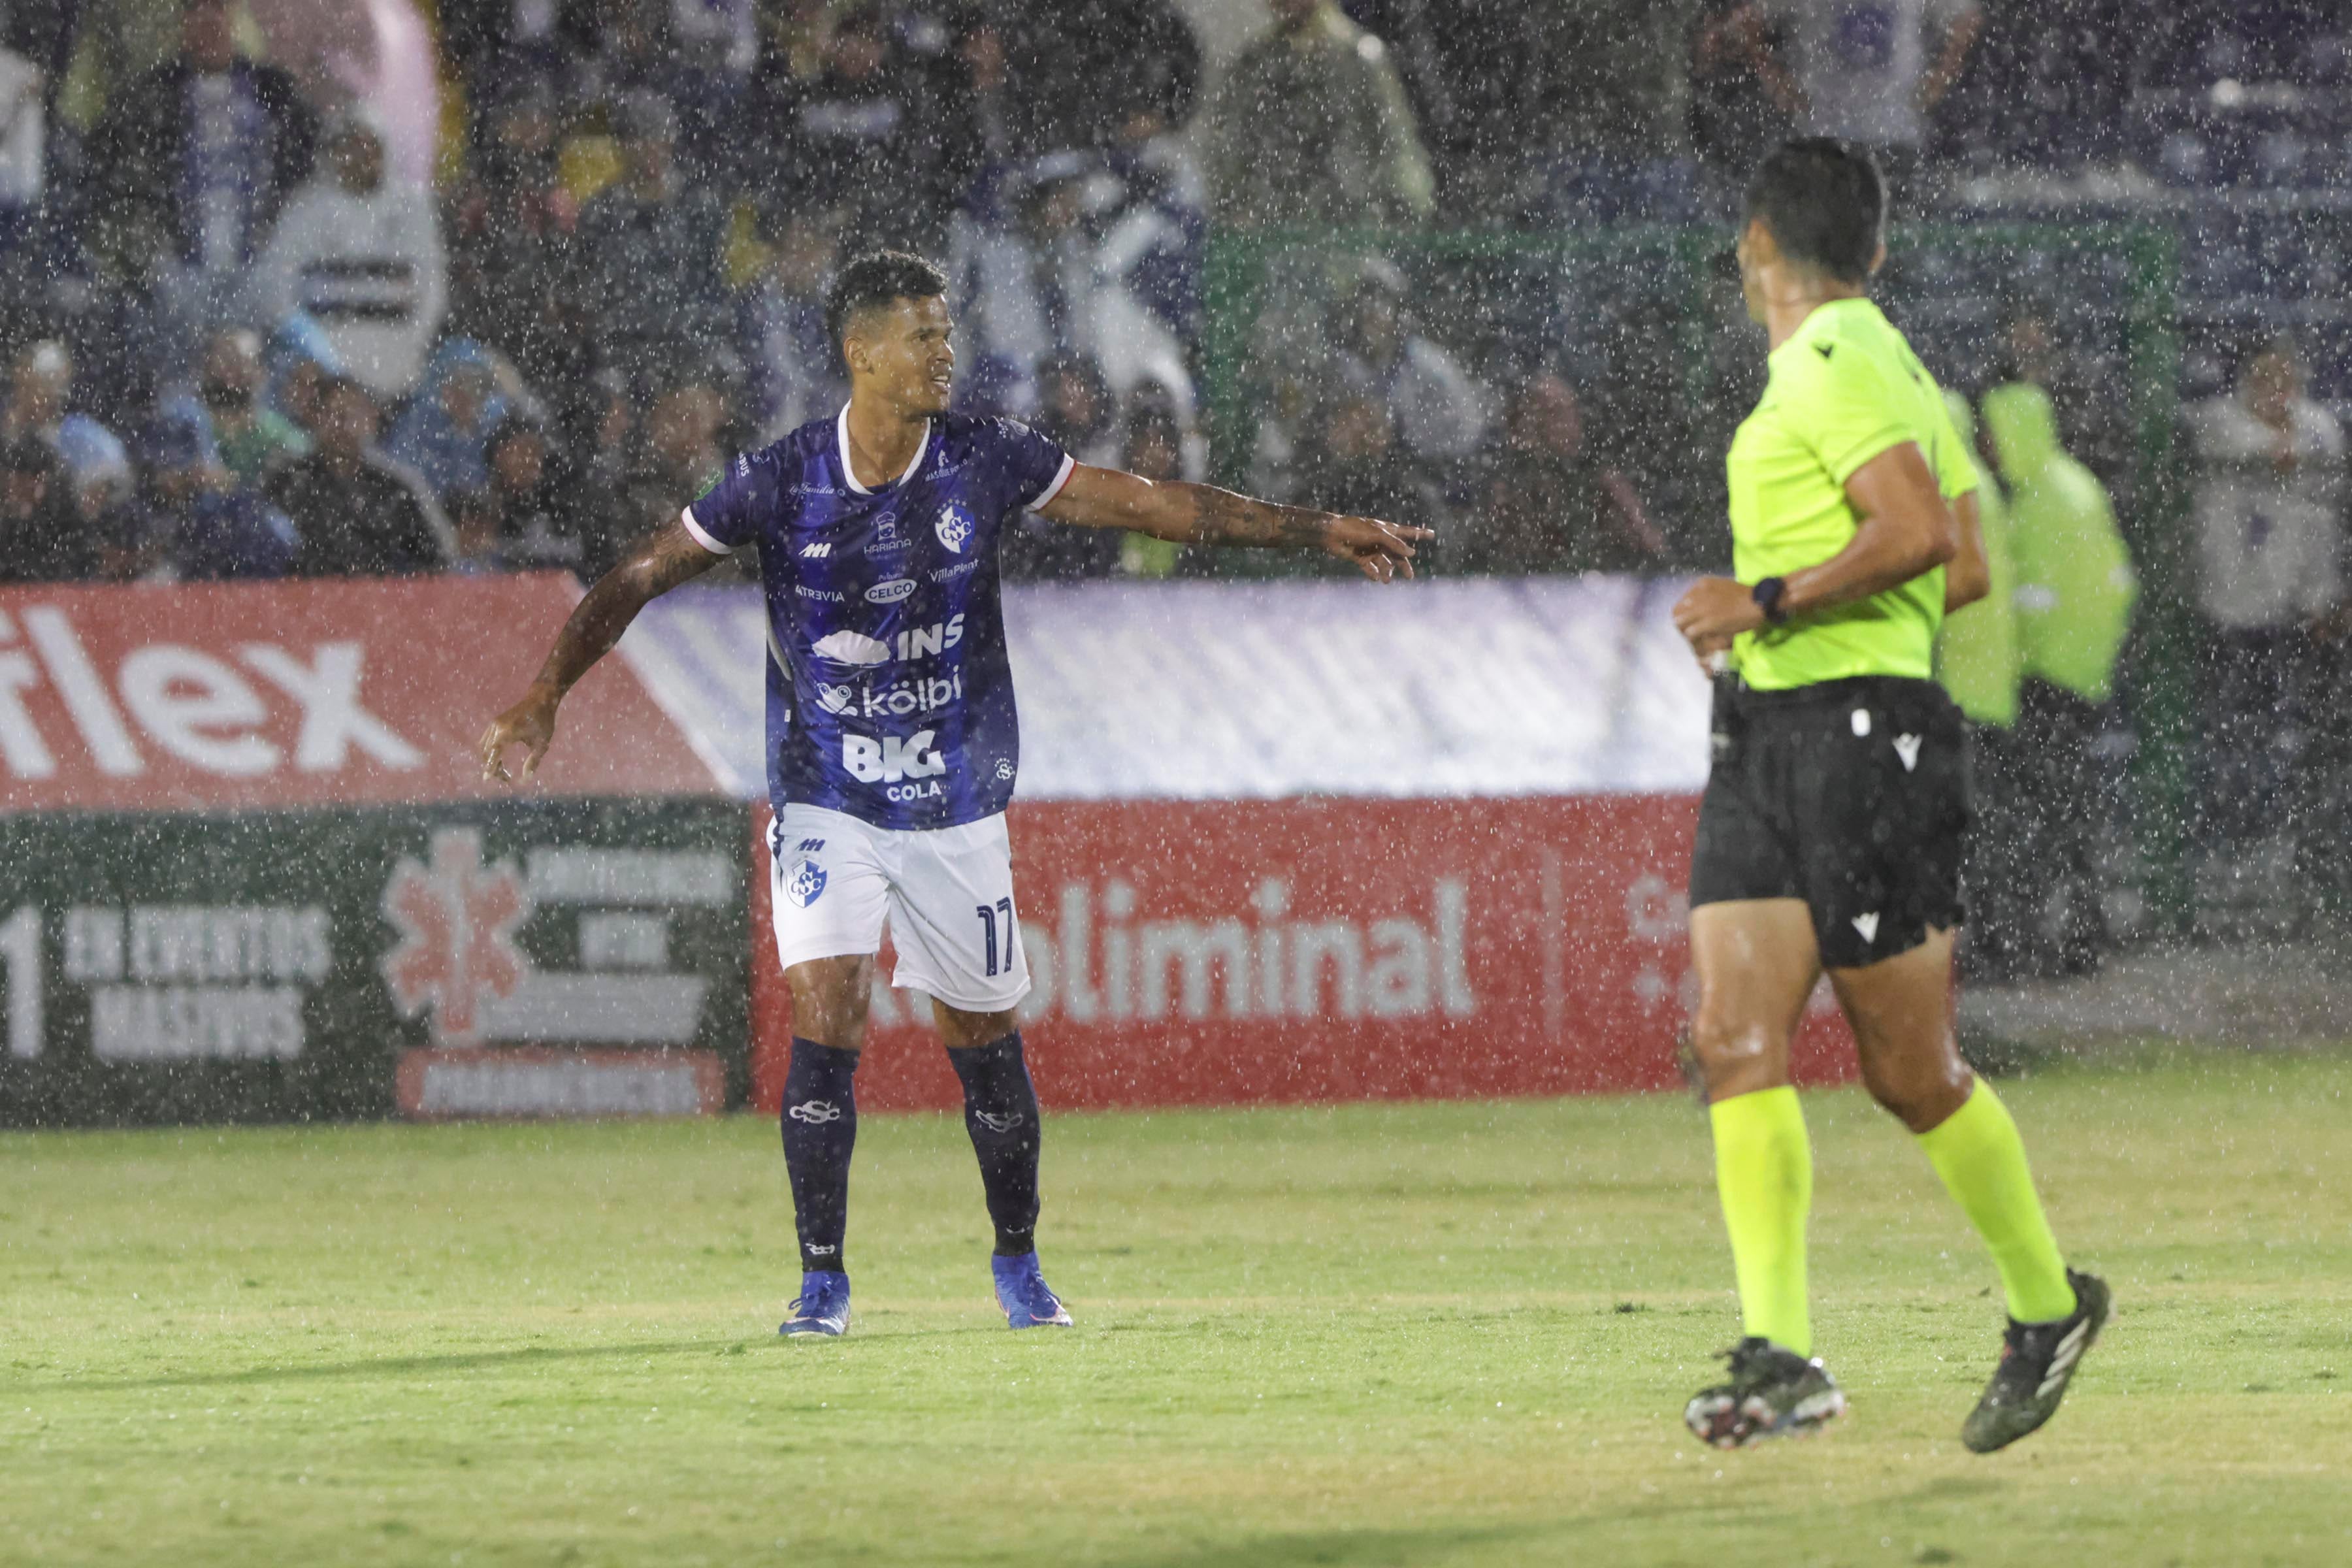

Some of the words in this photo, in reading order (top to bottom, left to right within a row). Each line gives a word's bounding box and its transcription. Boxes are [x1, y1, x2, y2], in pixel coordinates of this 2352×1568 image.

[864, 538, 911, 555] HARIANA
[868, 583, 912, 600] CELCO
[898, 613, 965, 661] INS
[862, 665, 962, 717] kölbi
[843, 730, 946, 783] BIG
[887, 781, 941, 802] COLA
[977, 896, 1012, 976] 17
